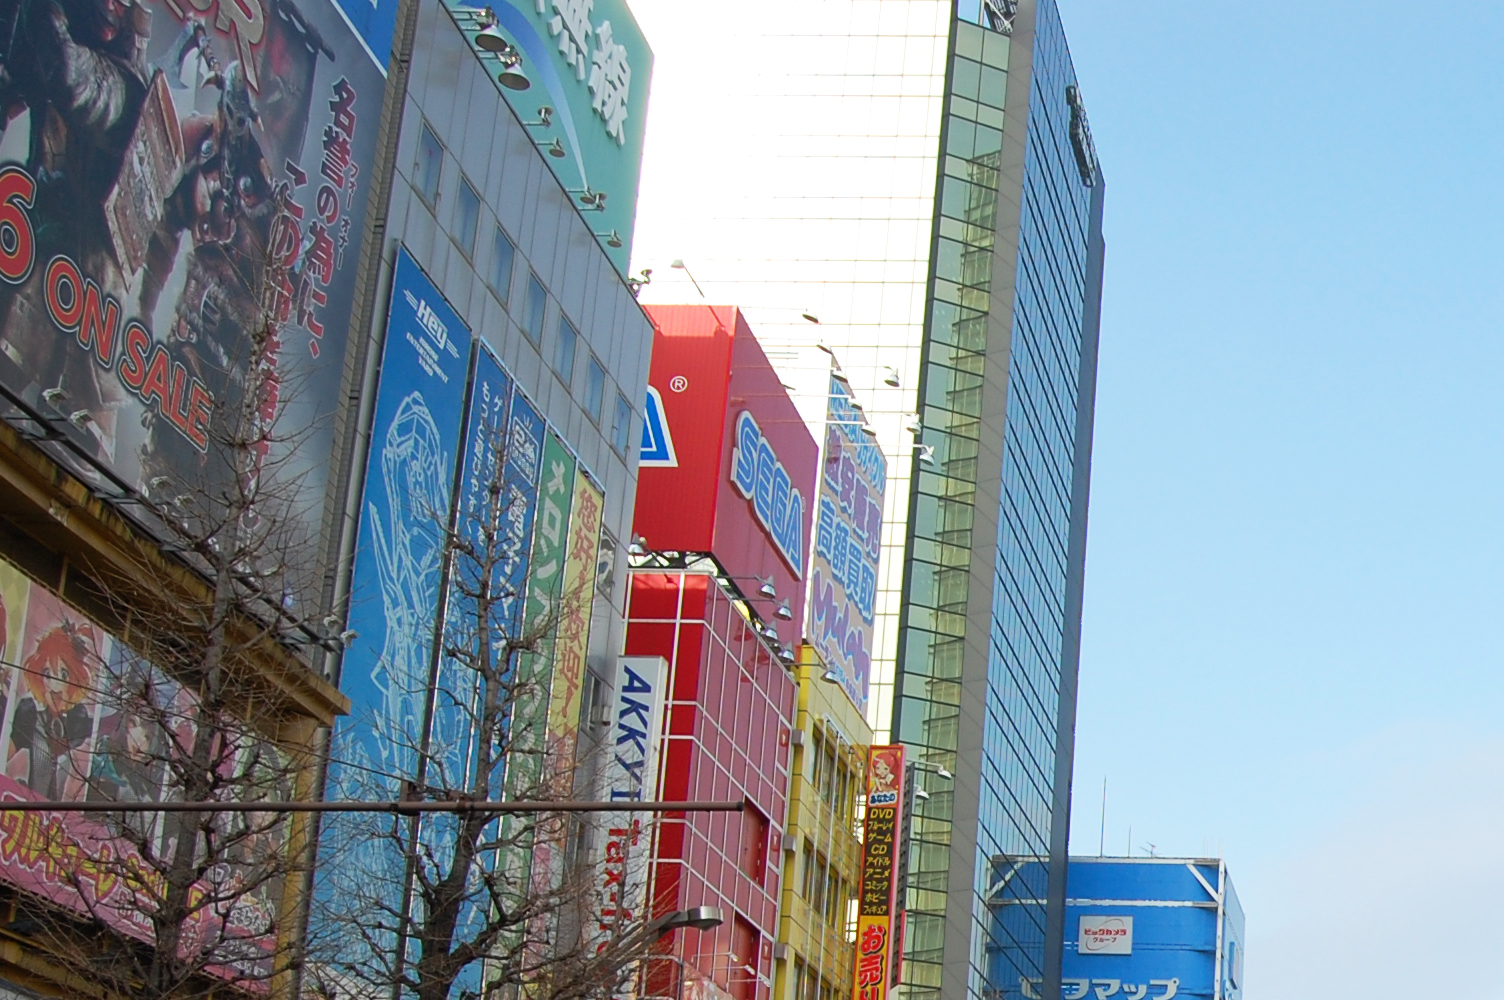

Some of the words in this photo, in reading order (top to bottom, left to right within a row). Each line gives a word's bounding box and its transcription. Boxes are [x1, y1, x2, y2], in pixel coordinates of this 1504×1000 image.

[417, 298, 448, 349] Hey
[45, 255, 118, 368] ON
[119, 322, 213, 452] SALE
[732, 410, 804, 582] SEGA
[816, 495, 876, 627] 高額買取
[611, 663, 653, 792] AKKY
[870, 808, 894, 819] DVD
[867, 832, 893, 843] ゲーム
[870, 844, 888, 855] CD
[866, 856, 891, 866] アイドル
[864, 868, 891, 878] アニメ
[864, 881, 889, 891] コミック
[864, 893, 887, 903] ホビー
[863, 905, 888, 915] フィギュア
